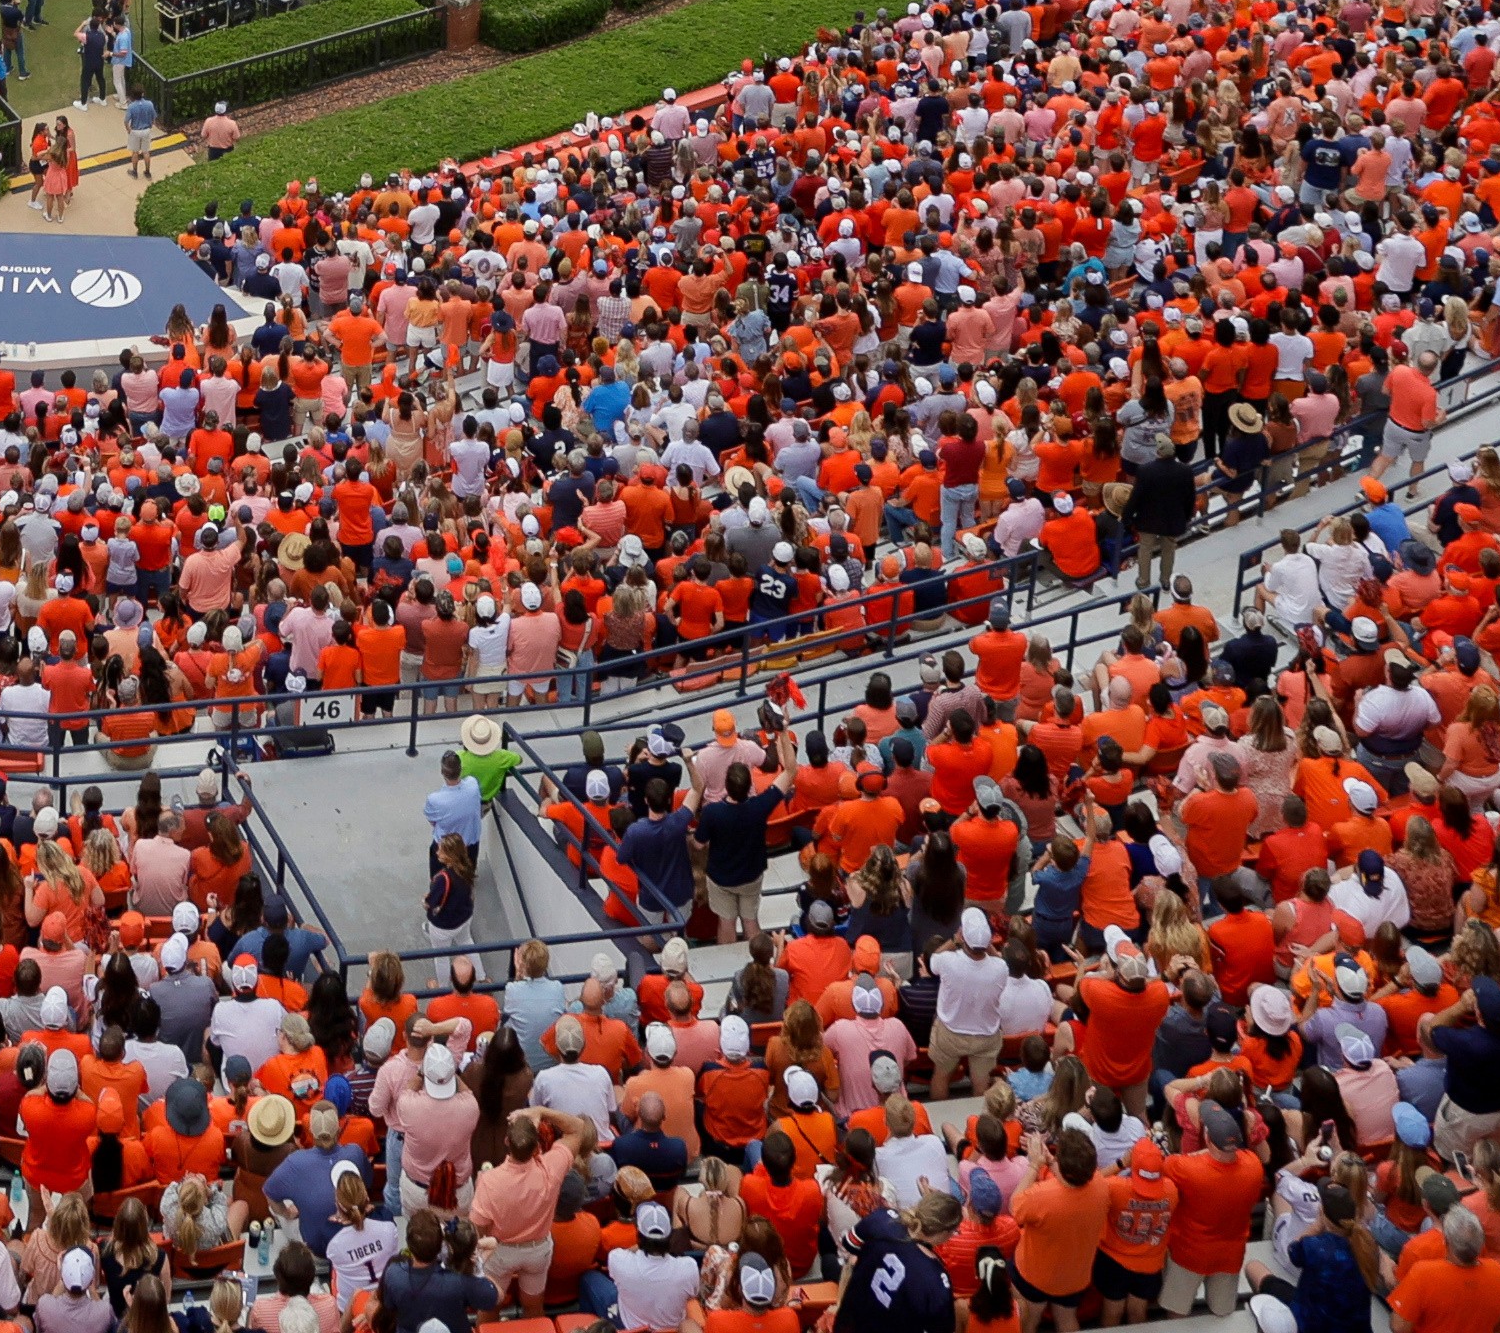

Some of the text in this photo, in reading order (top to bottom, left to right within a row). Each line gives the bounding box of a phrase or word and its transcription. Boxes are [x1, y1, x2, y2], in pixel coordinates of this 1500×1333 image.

[0, 266, 52, 276] Atmore
[769, 284, 790, 303] 34
[760, 573, 786, 599] 23
[312, 701, 340, 720] 46
[347, 1239, 383, 1261] TIGERS
[364, 1260, 380, 1284] 1
[871, 1253, 905, 1308] 2
